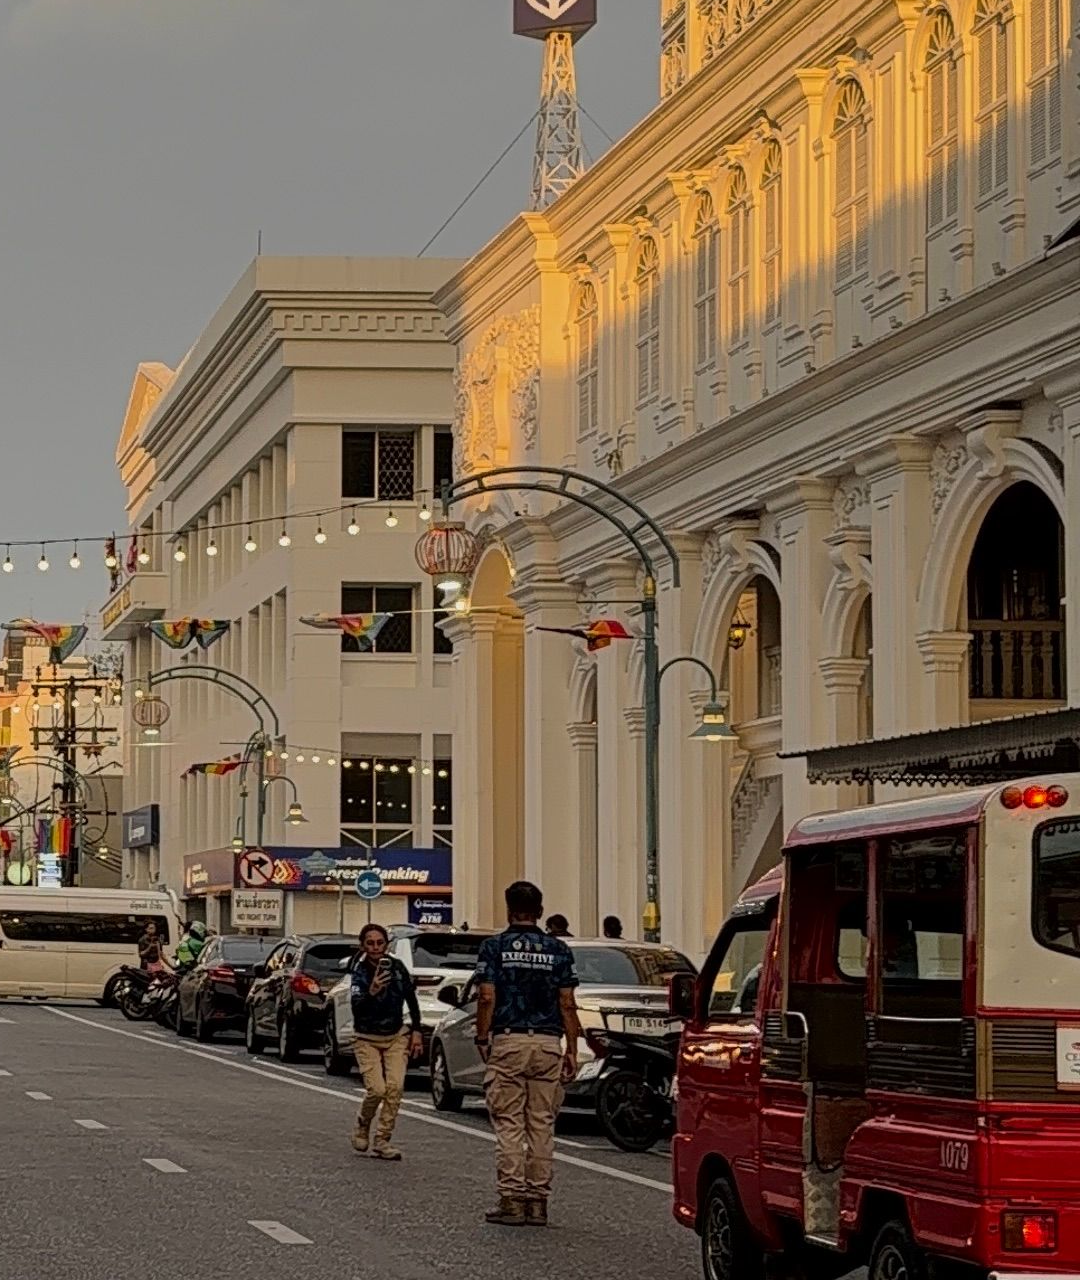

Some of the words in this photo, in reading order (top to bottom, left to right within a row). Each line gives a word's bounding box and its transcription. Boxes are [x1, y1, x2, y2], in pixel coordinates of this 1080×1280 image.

[419, 914, 442, 924] ATM
[501, 951, 554, 964] EXECUTIVE
[939, 1140, 969, 1170] 1079
